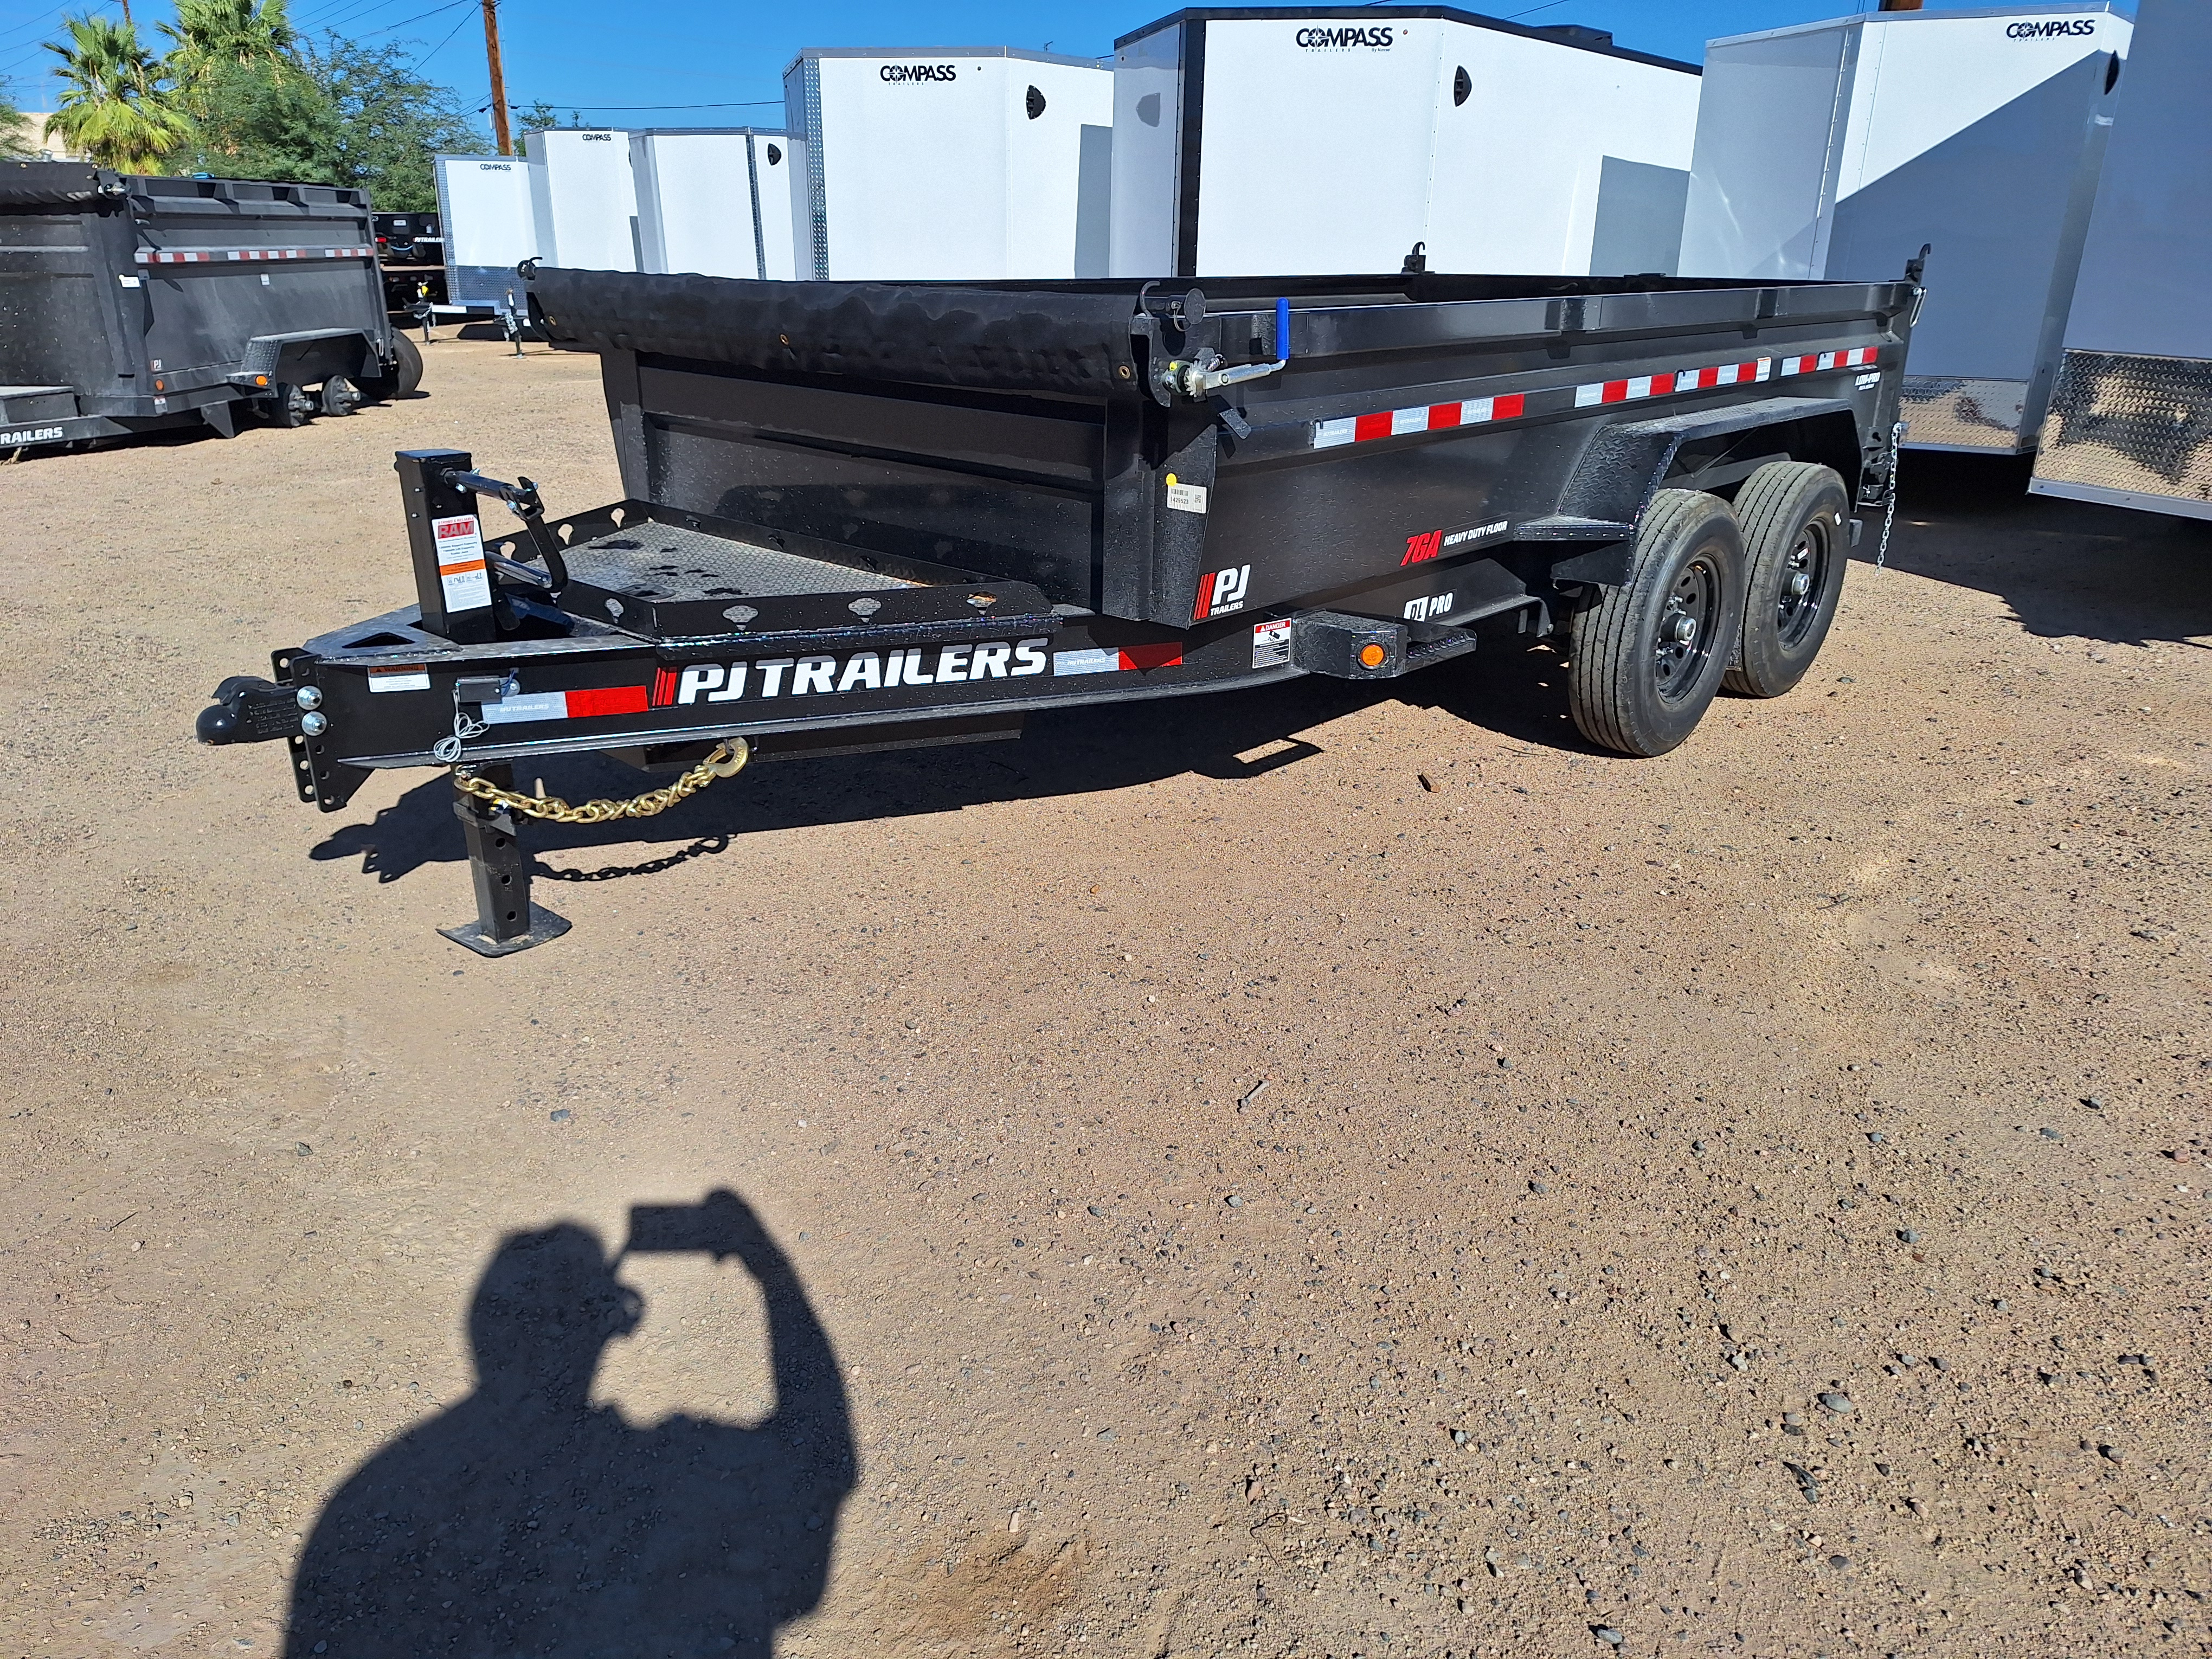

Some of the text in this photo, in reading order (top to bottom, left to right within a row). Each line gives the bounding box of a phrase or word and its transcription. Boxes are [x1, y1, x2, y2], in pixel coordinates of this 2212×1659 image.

[2006, 19, 2096, 38] COMPASS
[1296, 27, 1393, 48] COMPASS
[880, 65, 956, 82] COMPASS
[582, 133, 612, 142] COMPASS
[153, 358, 162, 369] PJ
[1171, 497, 1189, 505] 1429523
[439, 522, 474, 538] RAM
[1399, 520, 1508, 567] 7GA HEAVY DUTY FLOOR
[1211, 564, 1251, 606] PJ
[1210, 600, 1244, 616] TRAILERS
[1429, 592, 1454, 617] PRO
[1265, 621, 1286, 631] DANGER
[384, 664, 419, 672] WARNING
[677, 637, 1049, 705] PJ TRAILERS
